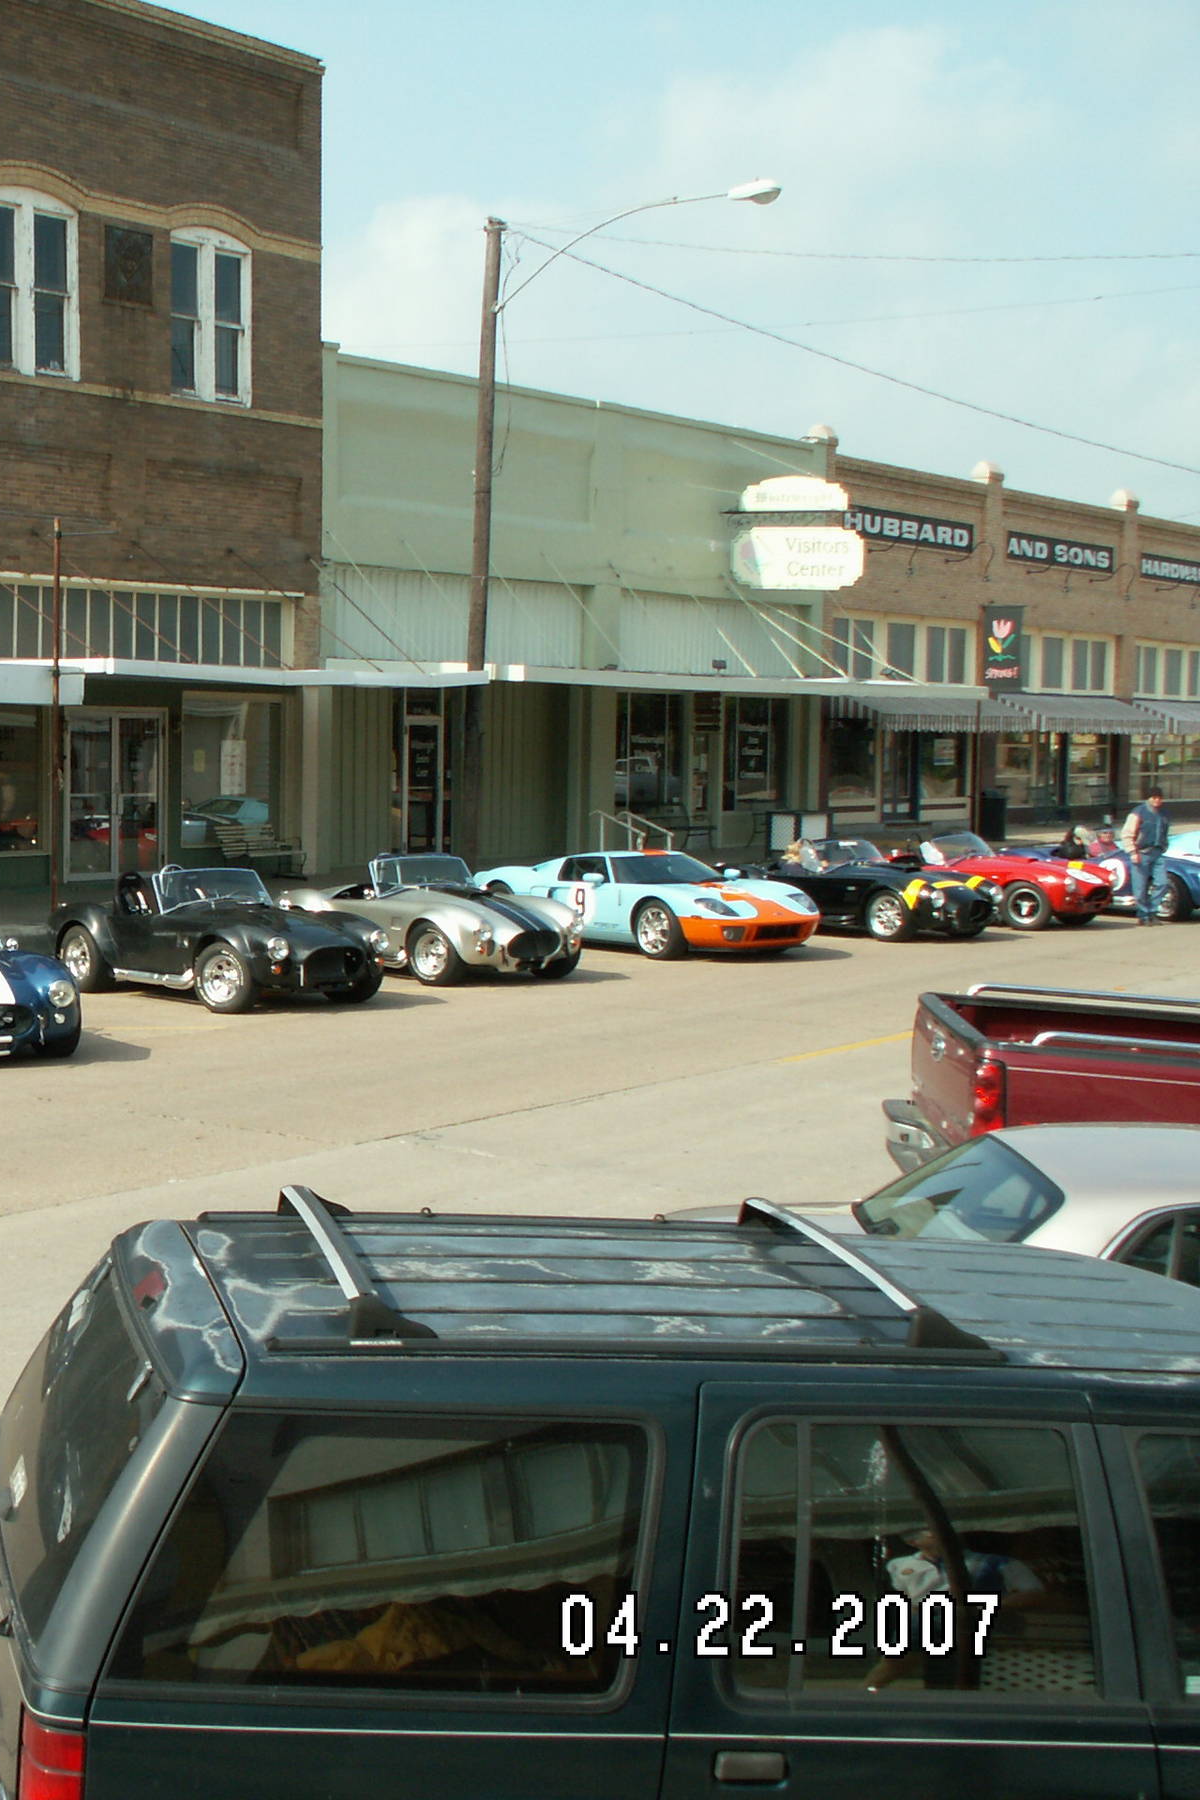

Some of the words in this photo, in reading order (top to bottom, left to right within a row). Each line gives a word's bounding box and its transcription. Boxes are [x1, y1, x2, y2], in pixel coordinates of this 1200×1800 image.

[843, 512, 971, 548] HUBBARD
[785, 537, 849, 555] Visitors
[1007, 537, 1048, 560] AND
[1054, 543, 1110, 569] SONS
[786, 560, 846, 578] Center
[1141, 557, 1200, 582] HARDWA
[575, 887, 586, 917] 9
